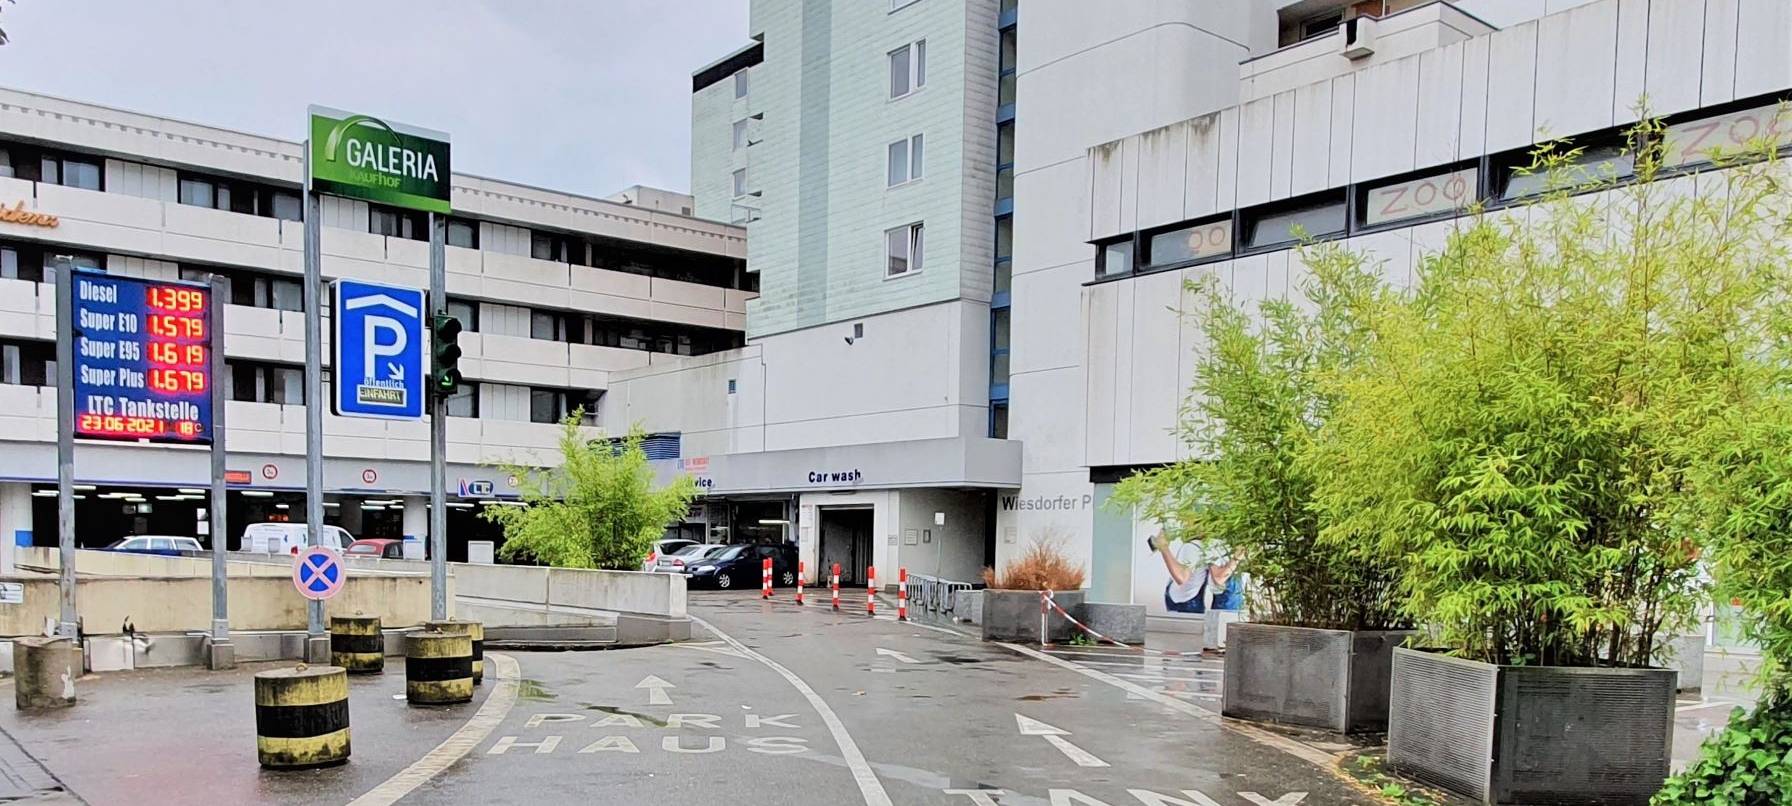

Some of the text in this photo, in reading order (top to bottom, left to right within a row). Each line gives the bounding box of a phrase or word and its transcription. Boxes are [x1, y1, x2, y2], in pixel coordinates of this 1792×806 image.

[346, 138, 439, 182] GALERIA
[80, 280, 203, 311] Diesel 1.399
[80, 307, 203, 336] Super E10 1.579
[80, 336, 203, 364] Super E95 1.619
[80, 364, 204, 391] Super Plus 1.679
[360, 387, 401, 401] EINFAHRT
[88, 395, 199, 420] LTC Tankstelle
[694, 476, 713, 488] vice
[808, 469, 861, 483] Car wash
[1002, 494, 1092, 511] Wiesdorfer P
[524, 713, 801, 728] PARK
[487, 735, 809, 754] HAUS
